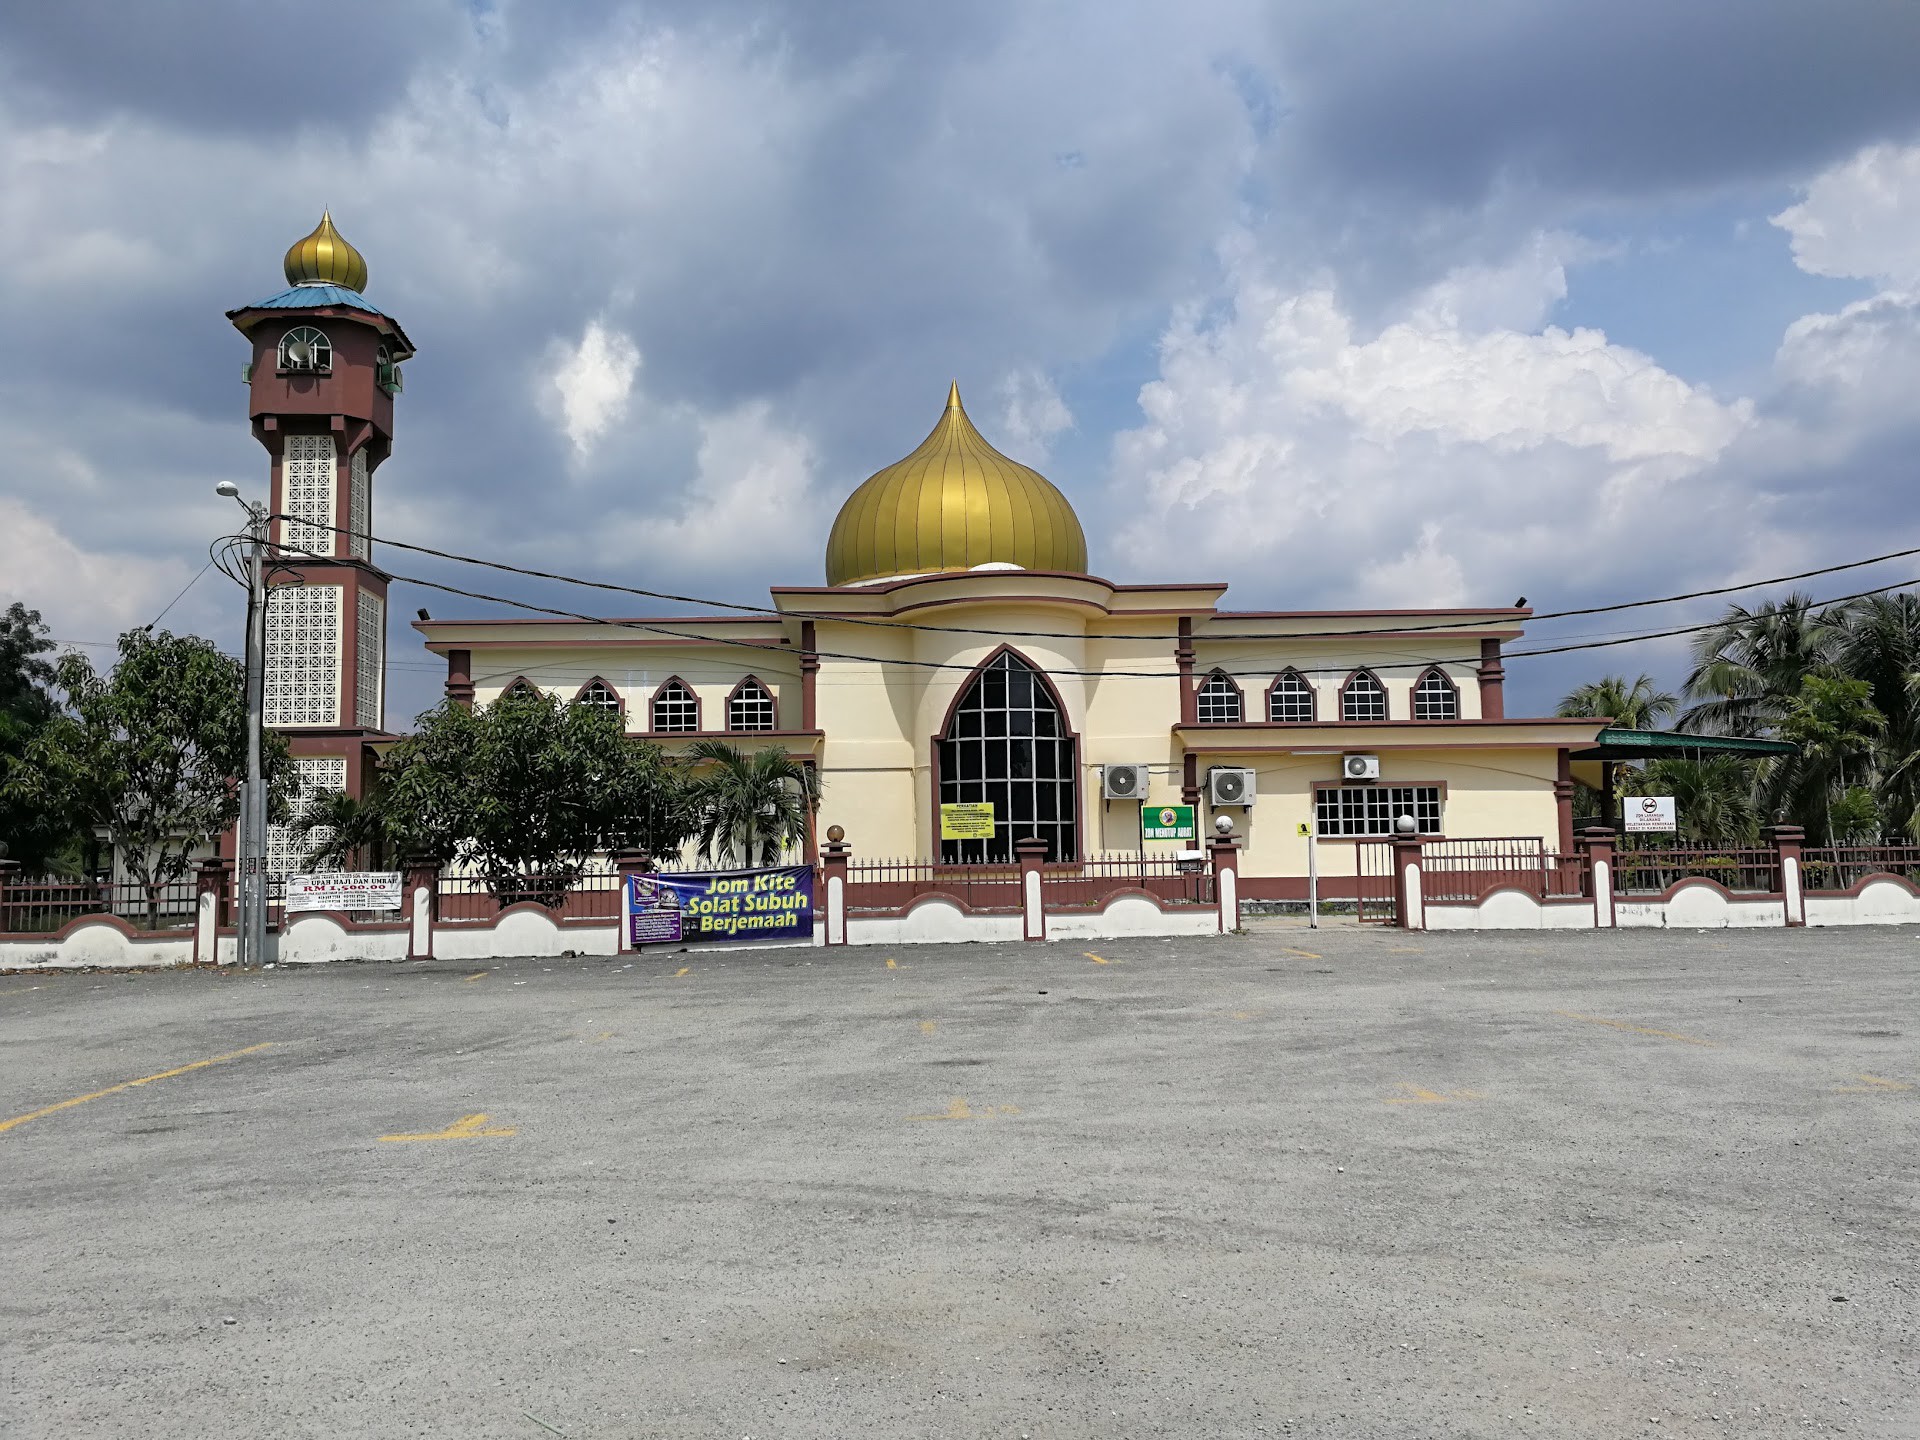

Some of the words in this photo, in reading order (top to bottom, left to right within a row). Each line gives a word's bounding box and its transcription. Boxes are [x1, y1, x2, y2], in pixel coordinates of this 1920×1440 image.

[1155, 827, 1176, 838] MENUTUP
[1177, 827, 1192, 837] AURAT
[705, 877, 749, 896] Jom
[753, 874, 796, 892] Kite
[688, 896, 740, 915] Solat
[744, 891, 808, 912] Subuh
[700, 911, 798, 935] Berjemaah
